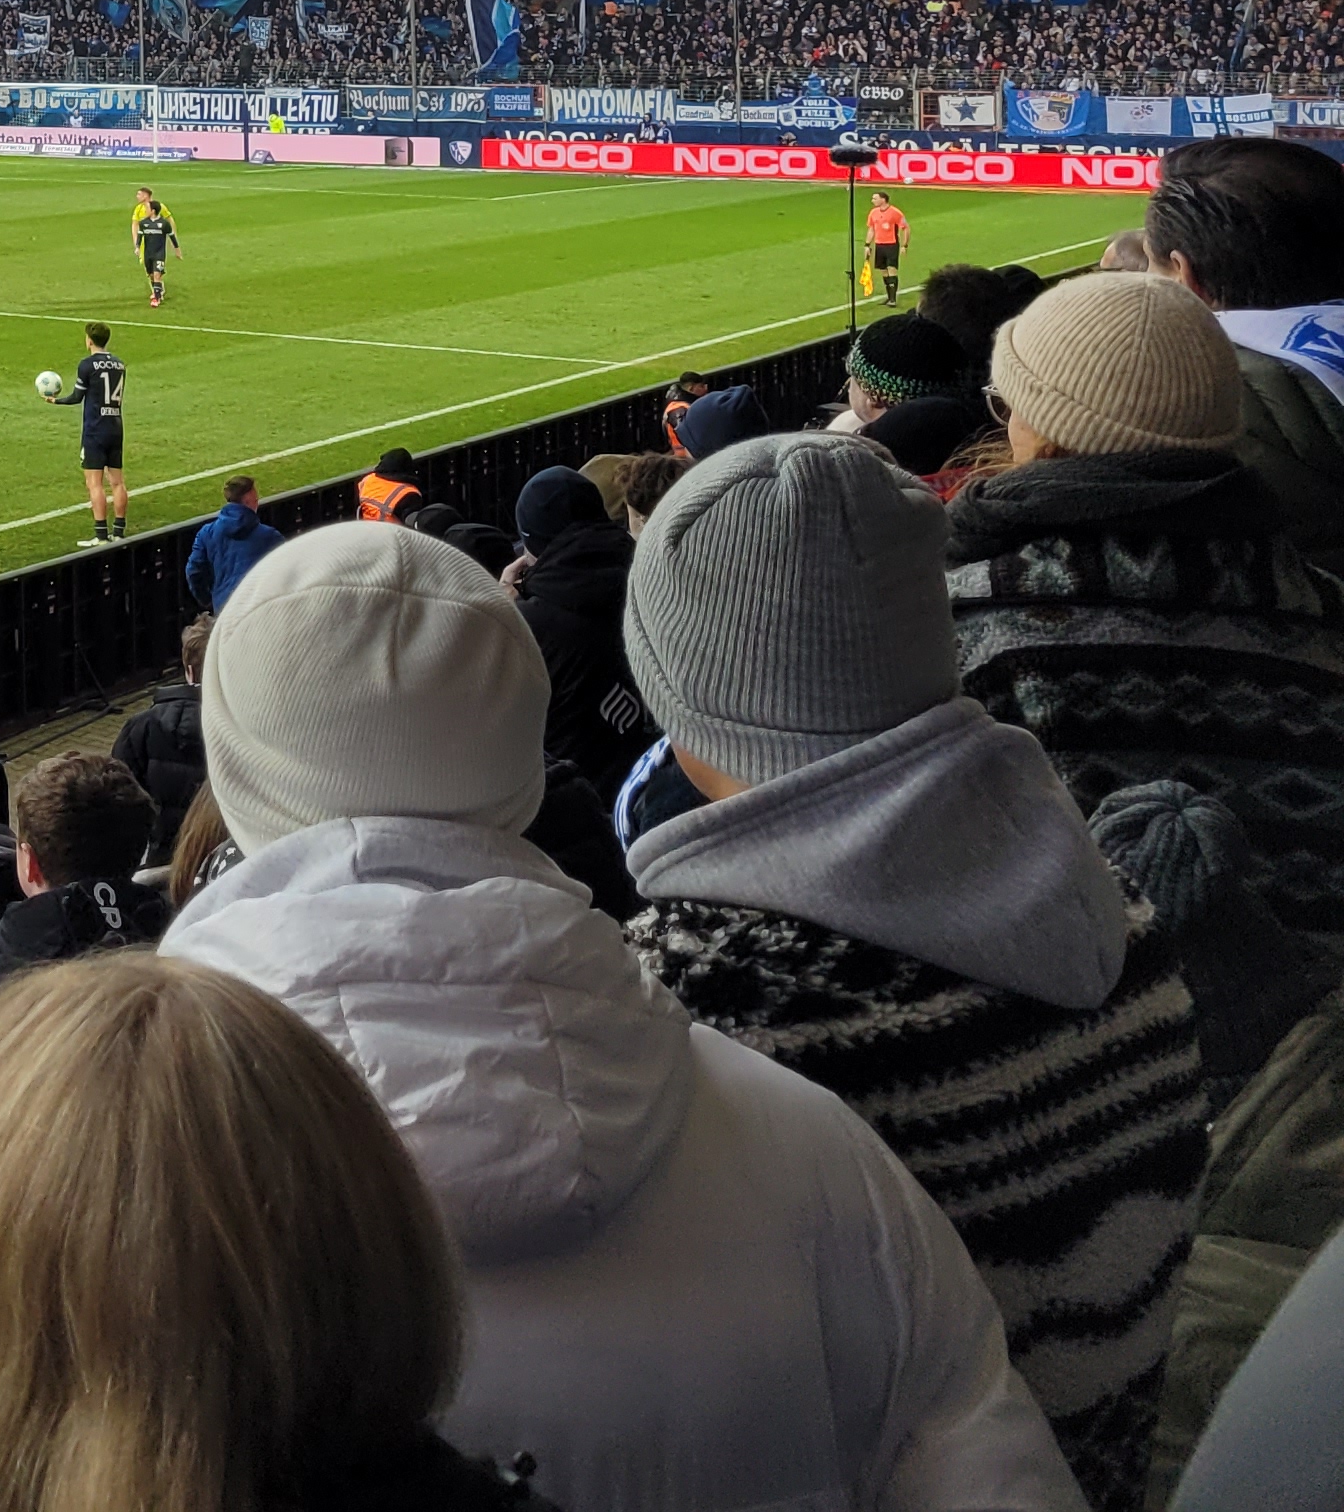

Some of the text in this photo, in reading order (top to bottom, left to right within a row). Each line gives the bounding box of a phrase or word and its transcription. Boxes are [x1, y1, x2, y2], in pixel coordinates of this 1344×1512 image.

[350, 90, 486, 115] Bochum Ost 1975
[494, 94, 530, 102] BOCHUM
[494, 103, 531, 111] NAZIFREI
[551, 88, 676, 125] PHOTOMAFIA
[802, 99, 829, 107] VOLLE
[1226, 110, 1269, 123] BOCHUM
[499, 142, 633, 170] NOCO
[673, 147, 817, 176] NOCO
[100, 371, 124, 406] 14
